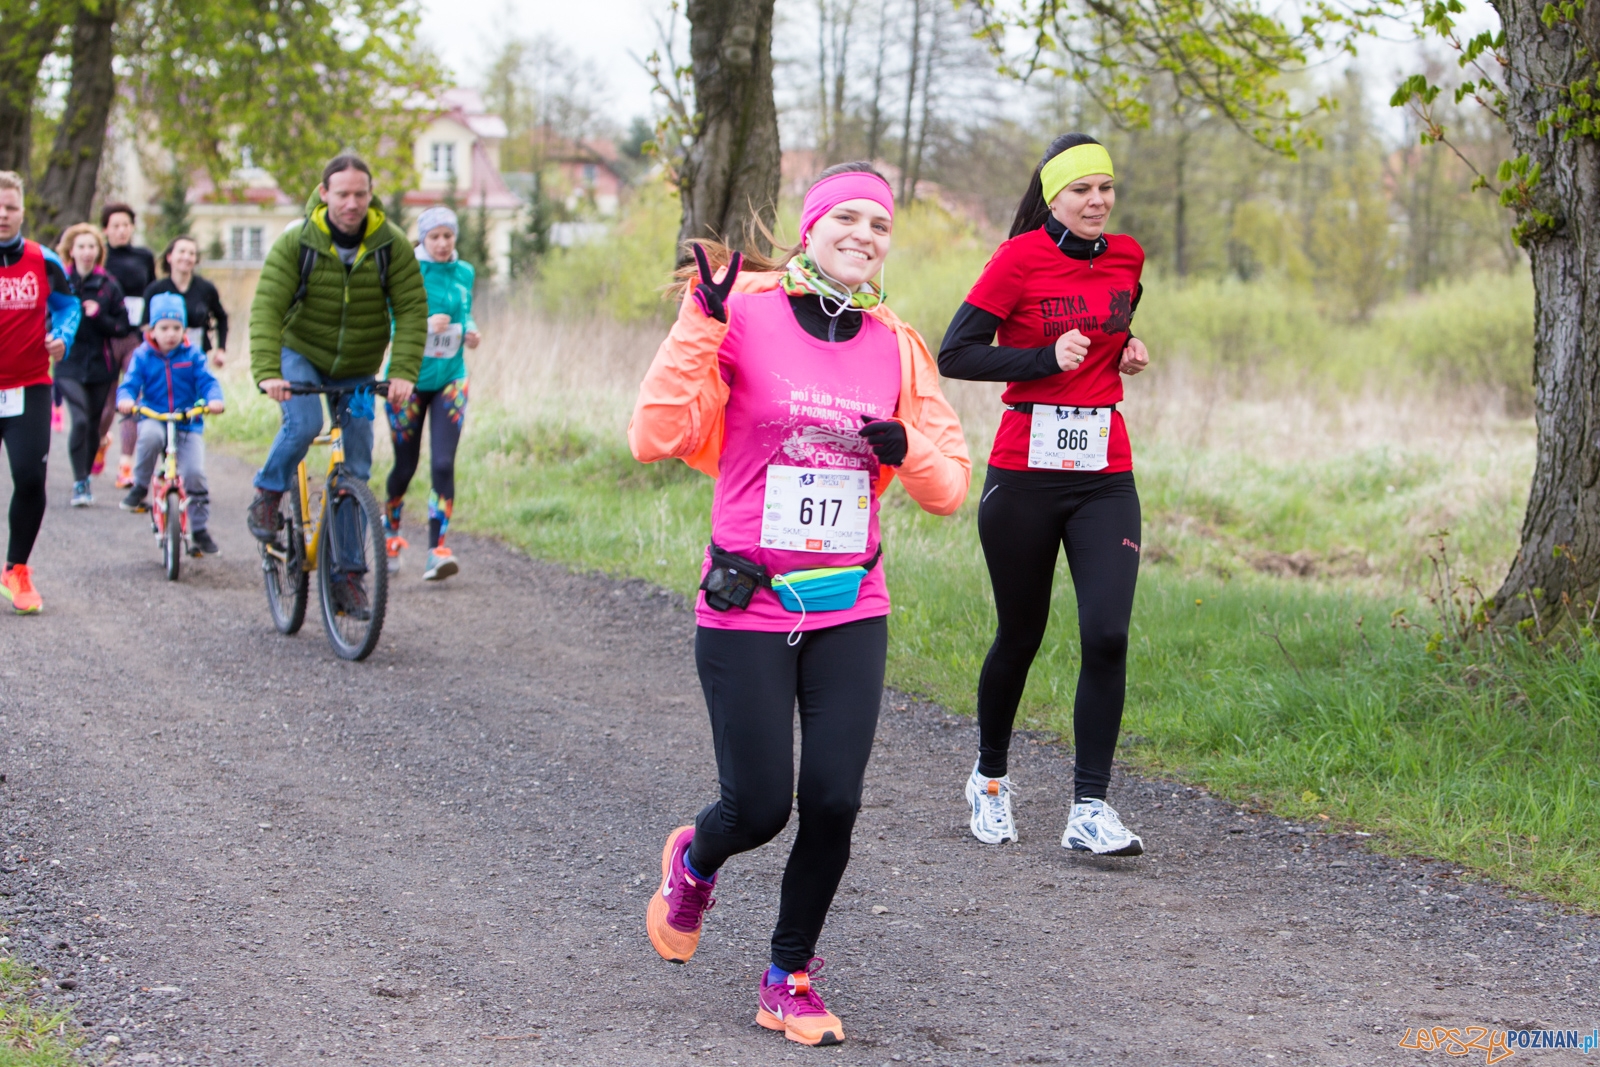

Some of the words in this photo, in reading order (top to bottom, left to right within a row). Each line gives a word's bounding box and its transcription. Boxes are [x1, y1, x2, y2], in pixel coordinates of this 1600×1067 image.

[1040, 295, 1089, 318] DZIKA
[790, 404, 800, 415] W
[1057, 428, 1088, 450] 866
[799, 497, 842, 527] 617
